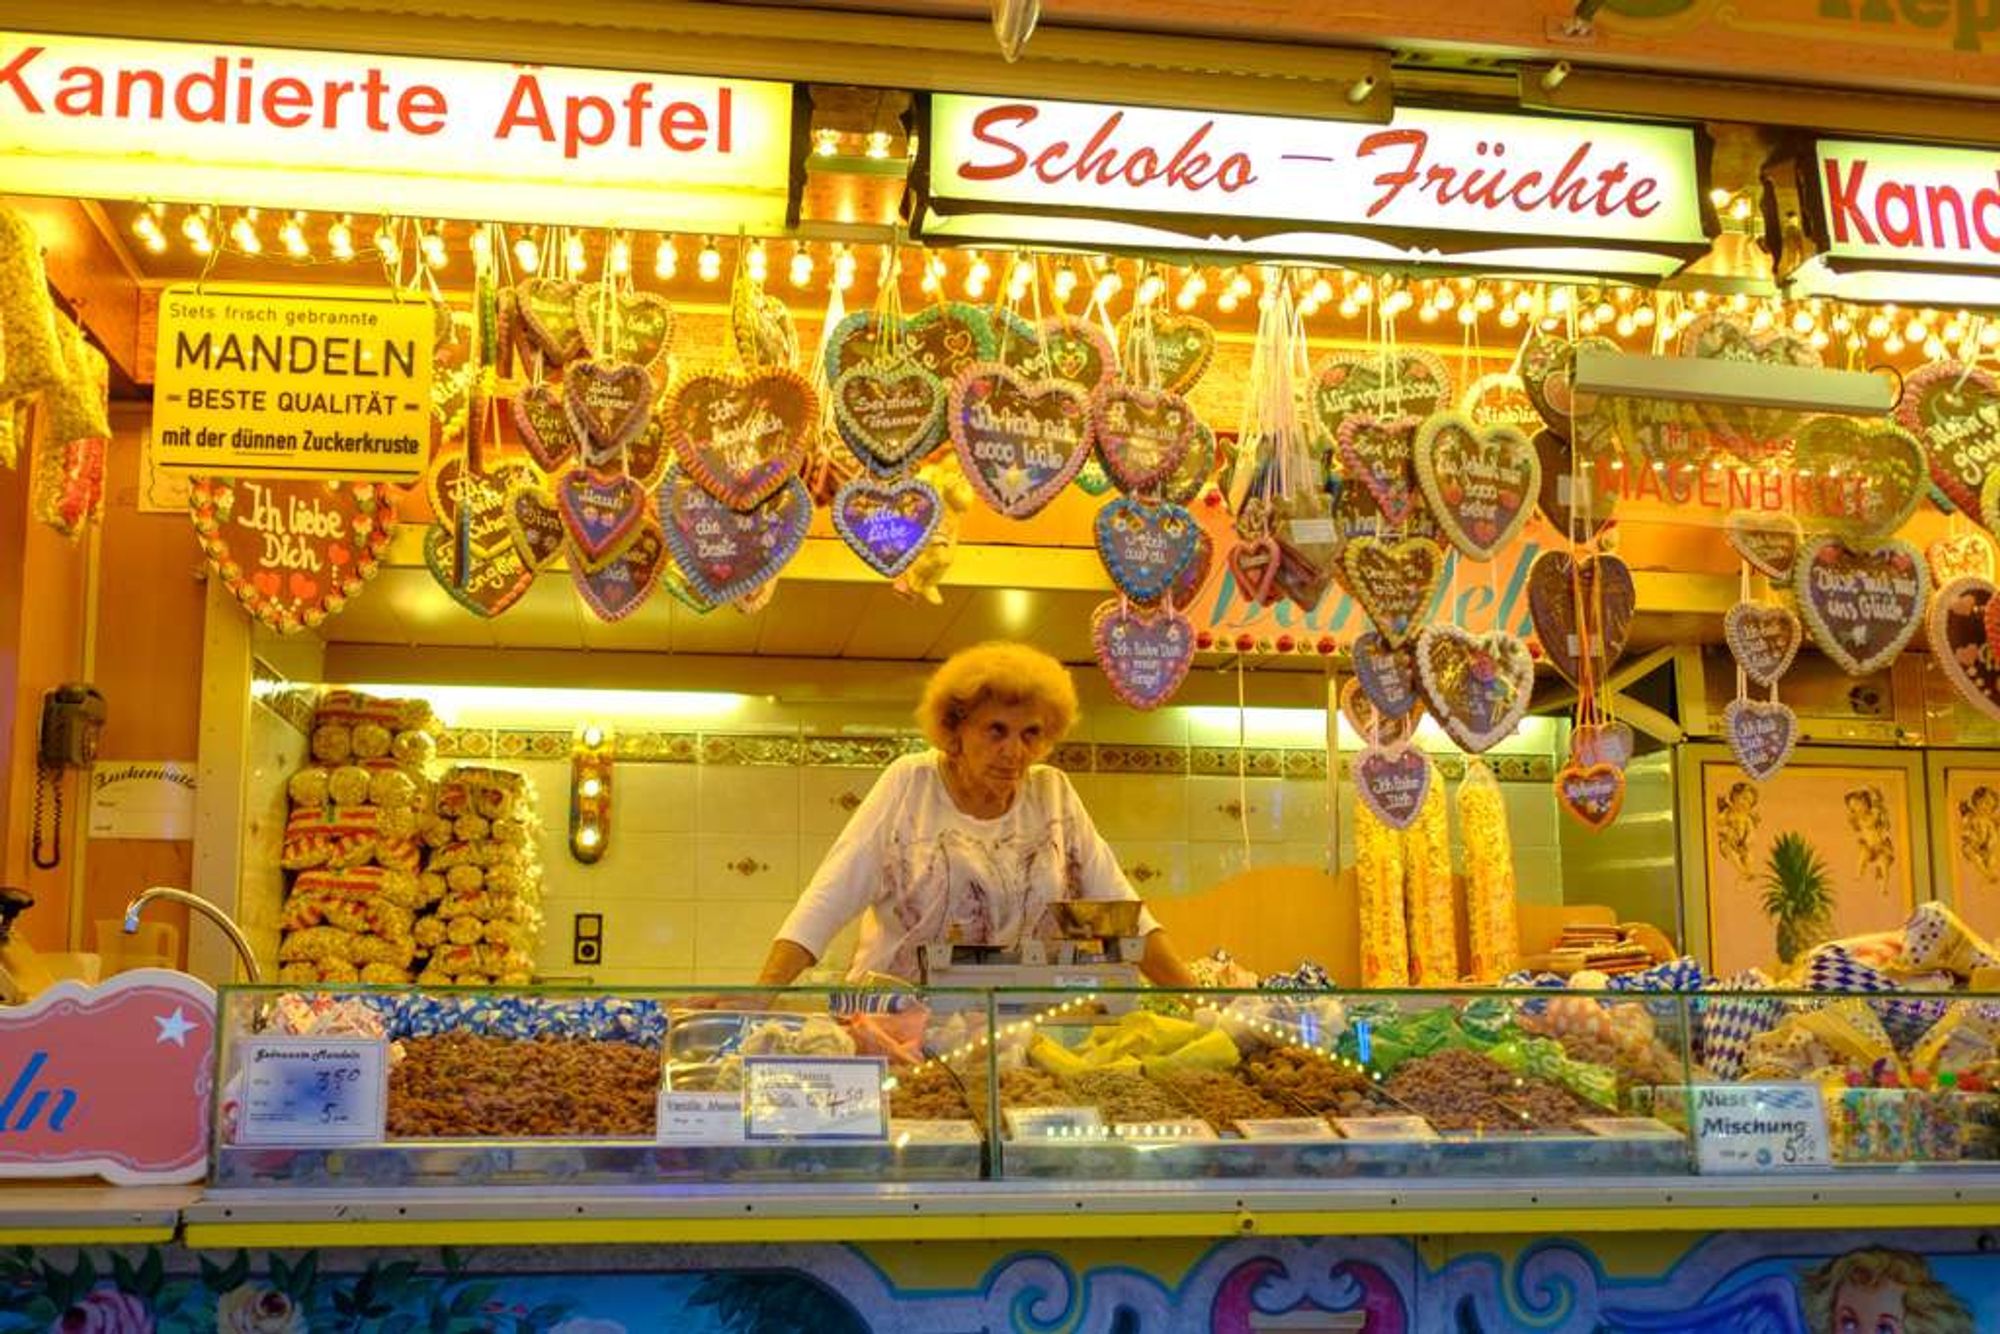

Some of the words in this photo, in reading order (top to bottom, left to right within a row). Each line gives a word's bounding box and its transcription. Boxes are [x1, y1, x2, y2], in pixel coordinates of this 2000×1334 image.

[0, 46, 448, 135] Kandierte
[494, 61, 734, 159] Äpfel
[957, 104, 1258, 192] Schoko
[1355, 129, 1663, 219] Früchte
[170, 303, 215, 319] Stets
[226, 304, 277, 322] frisch
[285, 310, 378, 328] gebrannte
[175, 331, 415, 378] MANDELN
[188, 388, 267, 411] BESTE
[278, 391, 398, 416] QUALITÄT
[162, 427, 190, 447] mit
[196, 428, 227, 449] der
[232, 429, 297, 451] dünnen
[303, 430, 419, 455] Zuckerkruste
[237, 482, 286, 535] Ich
[288, 497, 345, 539] liebe
[260, 532, 322, 572] Dich
[1701, 1116, 1807, 1141] Mischung
